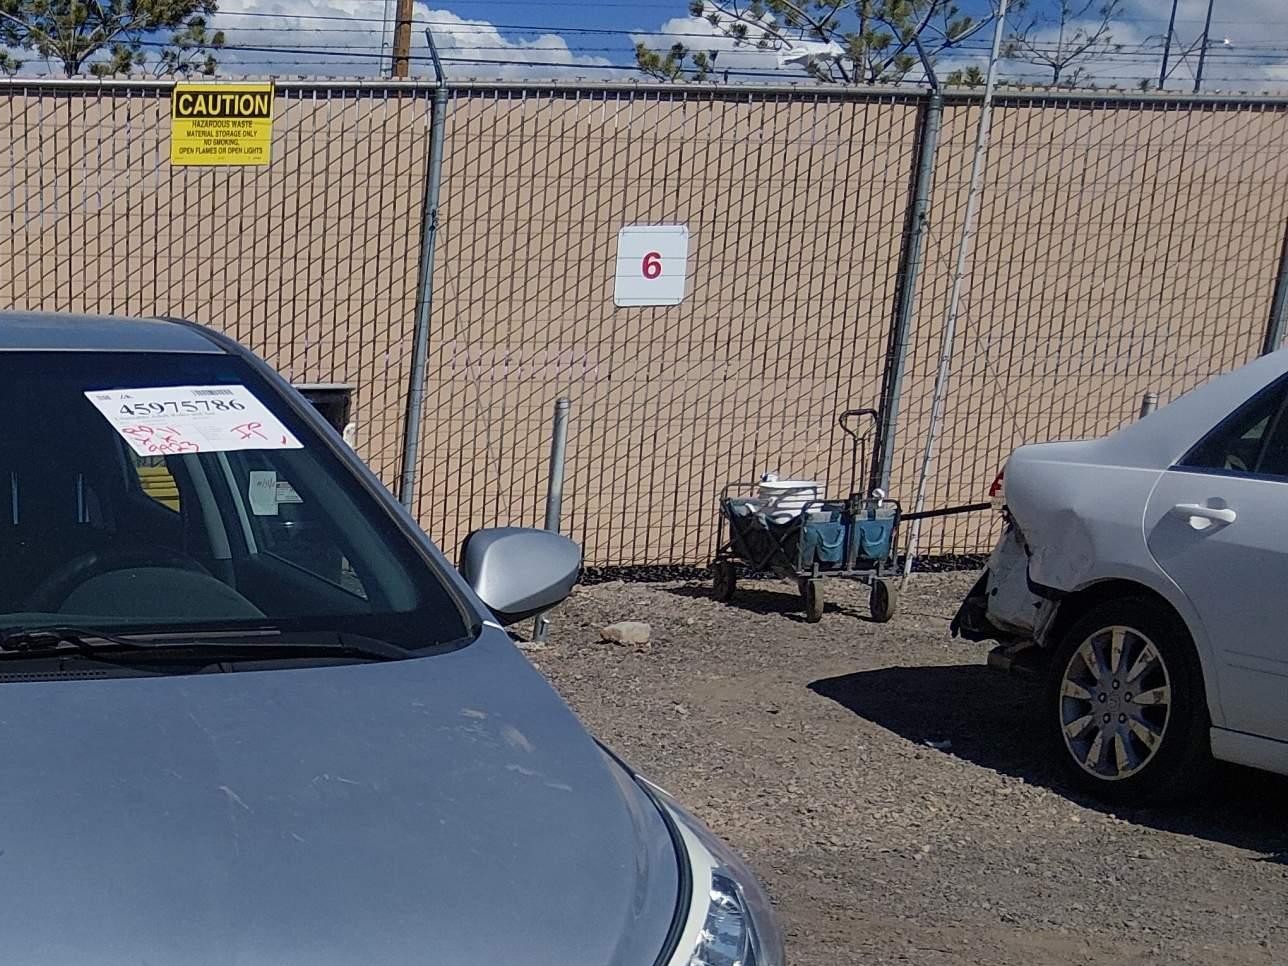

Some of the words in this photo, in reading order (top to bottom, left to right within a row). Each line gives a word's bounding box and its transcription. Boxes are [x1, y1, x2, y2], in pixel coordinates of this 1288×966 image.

[178, 94, 269, 116] CAUTION
[192, 120, 230, 128] HAZARDOUS
[232, 120, 253, 128] WASTE
[642, 252, 662, 279] 6
[119, 399, 246, 416] 45975786
